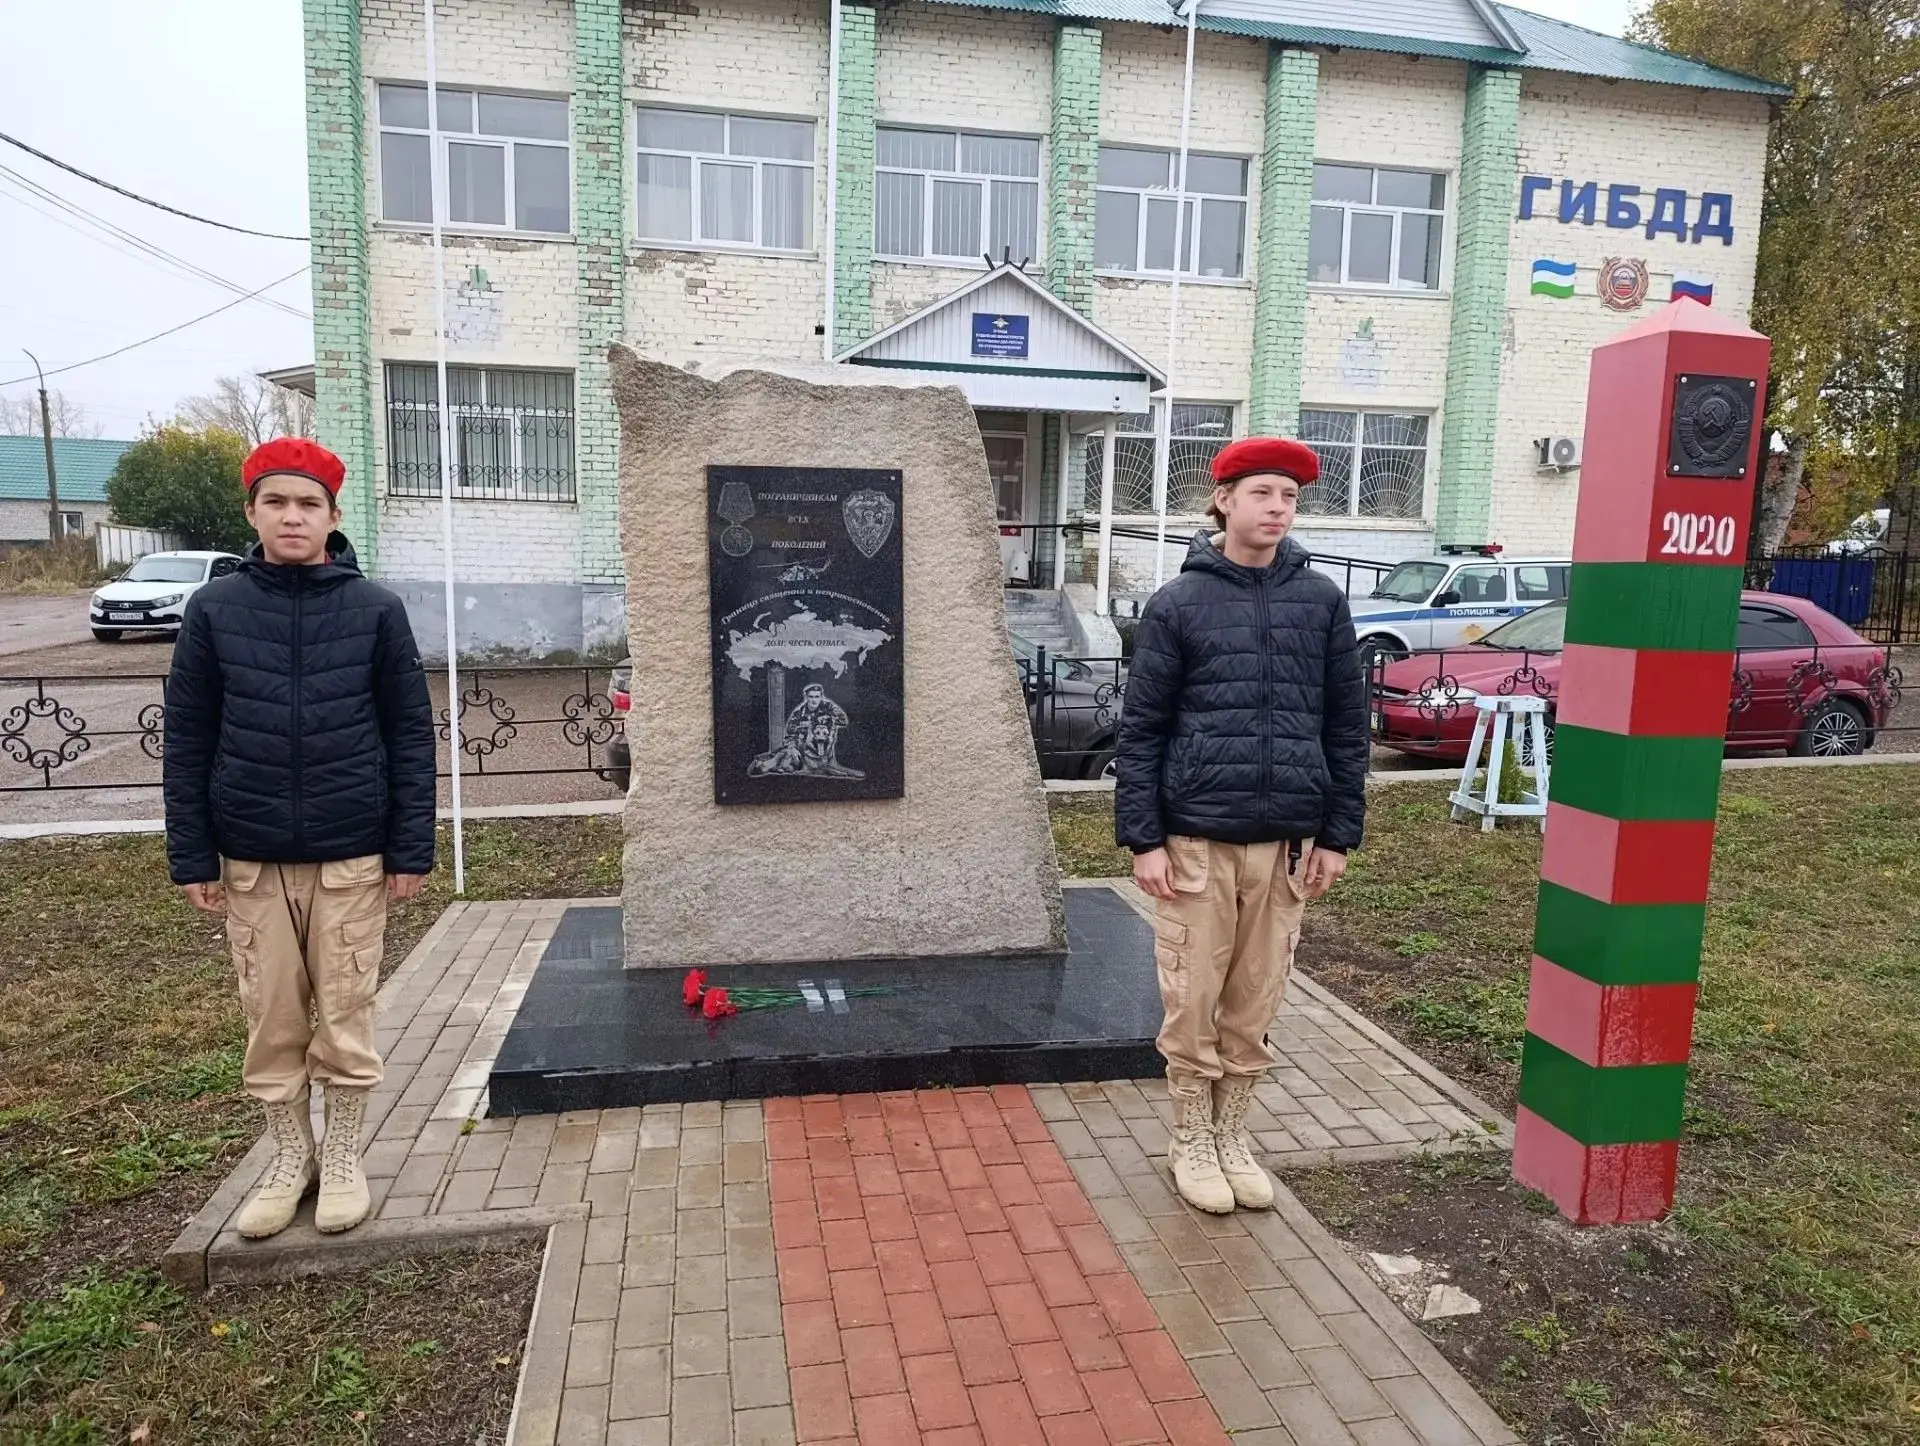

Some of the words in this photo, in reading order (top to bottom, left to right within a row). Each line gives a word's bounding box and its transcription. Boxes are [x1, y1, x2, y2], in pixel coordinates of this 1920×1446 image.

[1519, 175, 1734, 247] ГИБДД
[757, 492, 838, 502] ПОГРАНИЧНИКАМ
[1660, 511, 1736, 557] 2020
[771, 540, 827, 549] ПОКОЛЕНИЙ
[1449, 607, 1495, 617] ПОЛИЦИЯ
